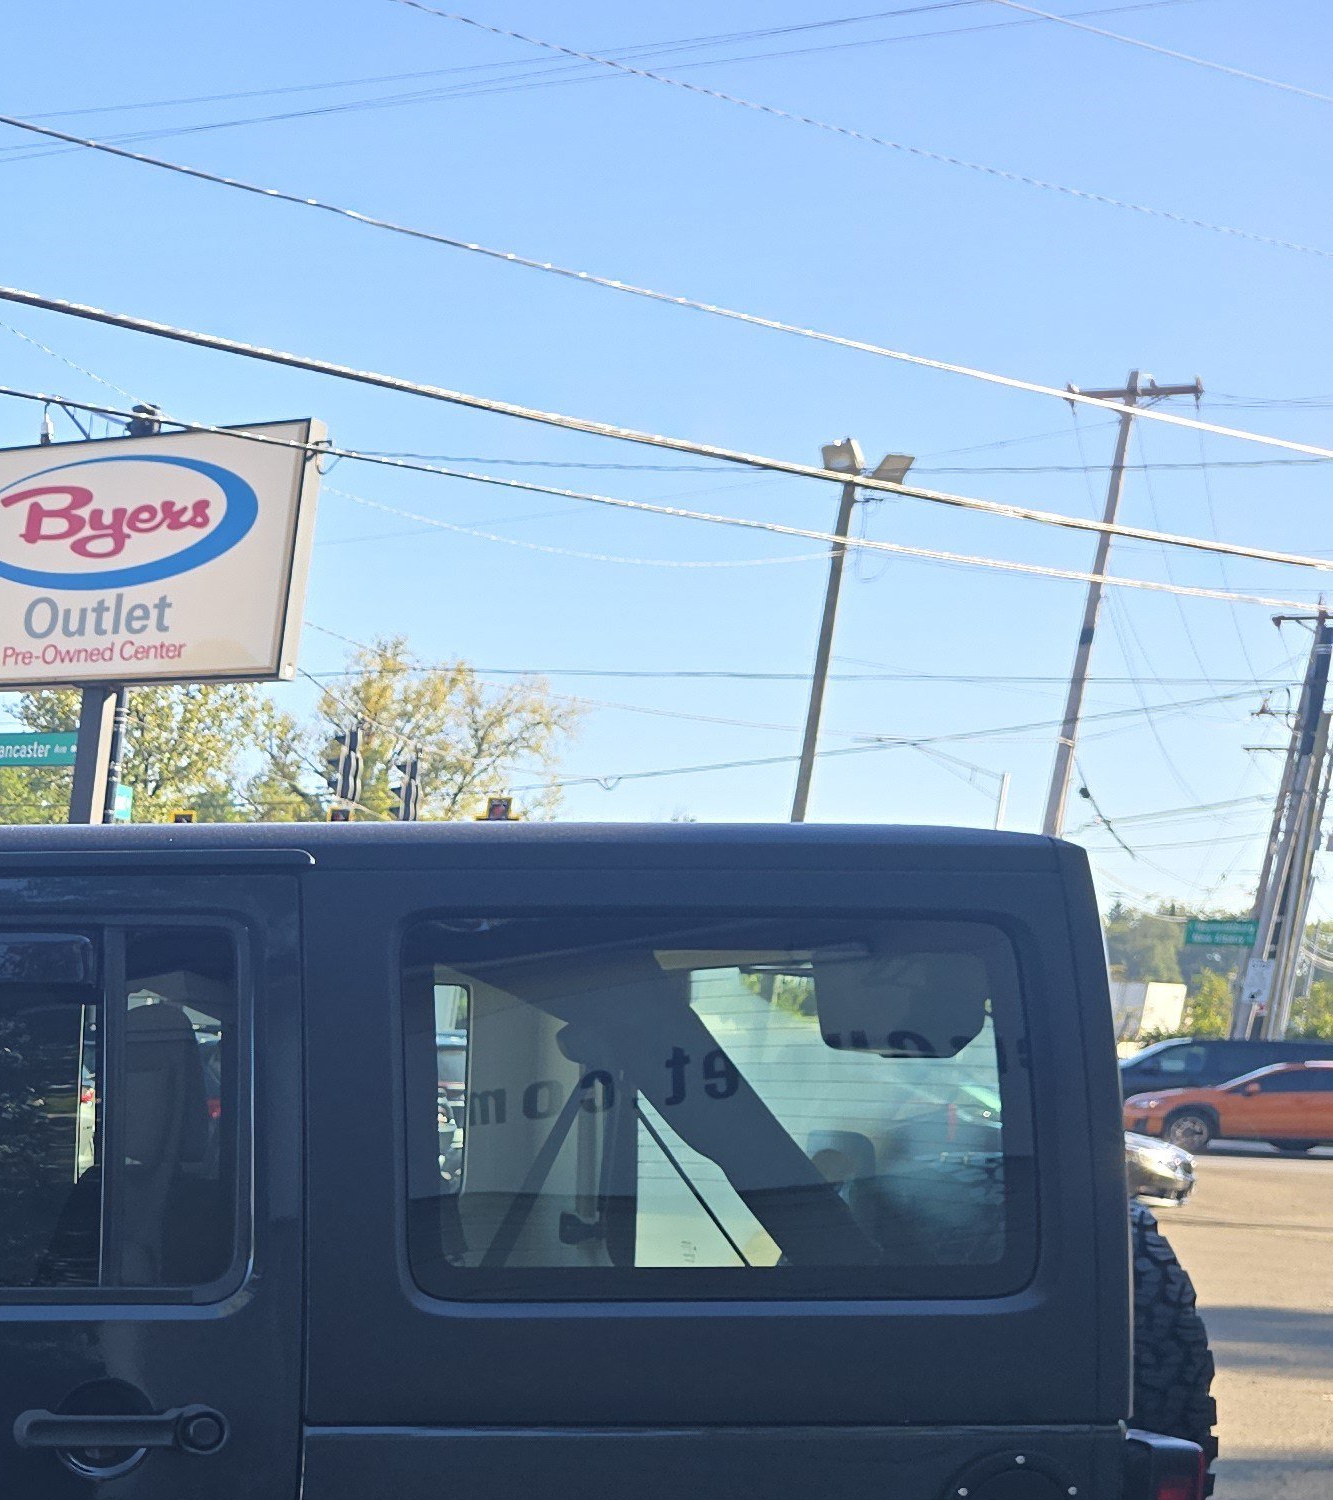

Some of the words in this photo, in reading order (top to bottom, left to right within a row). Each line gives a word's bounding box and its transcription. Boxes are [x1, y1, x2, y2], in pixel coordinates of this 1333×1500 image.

[0, 485, 210, 559] Byers
[23, 593, 172, 640] Outlet
[2, 642, 115, 666] Pre-Owned
[119, 640, 187, 661] Center
